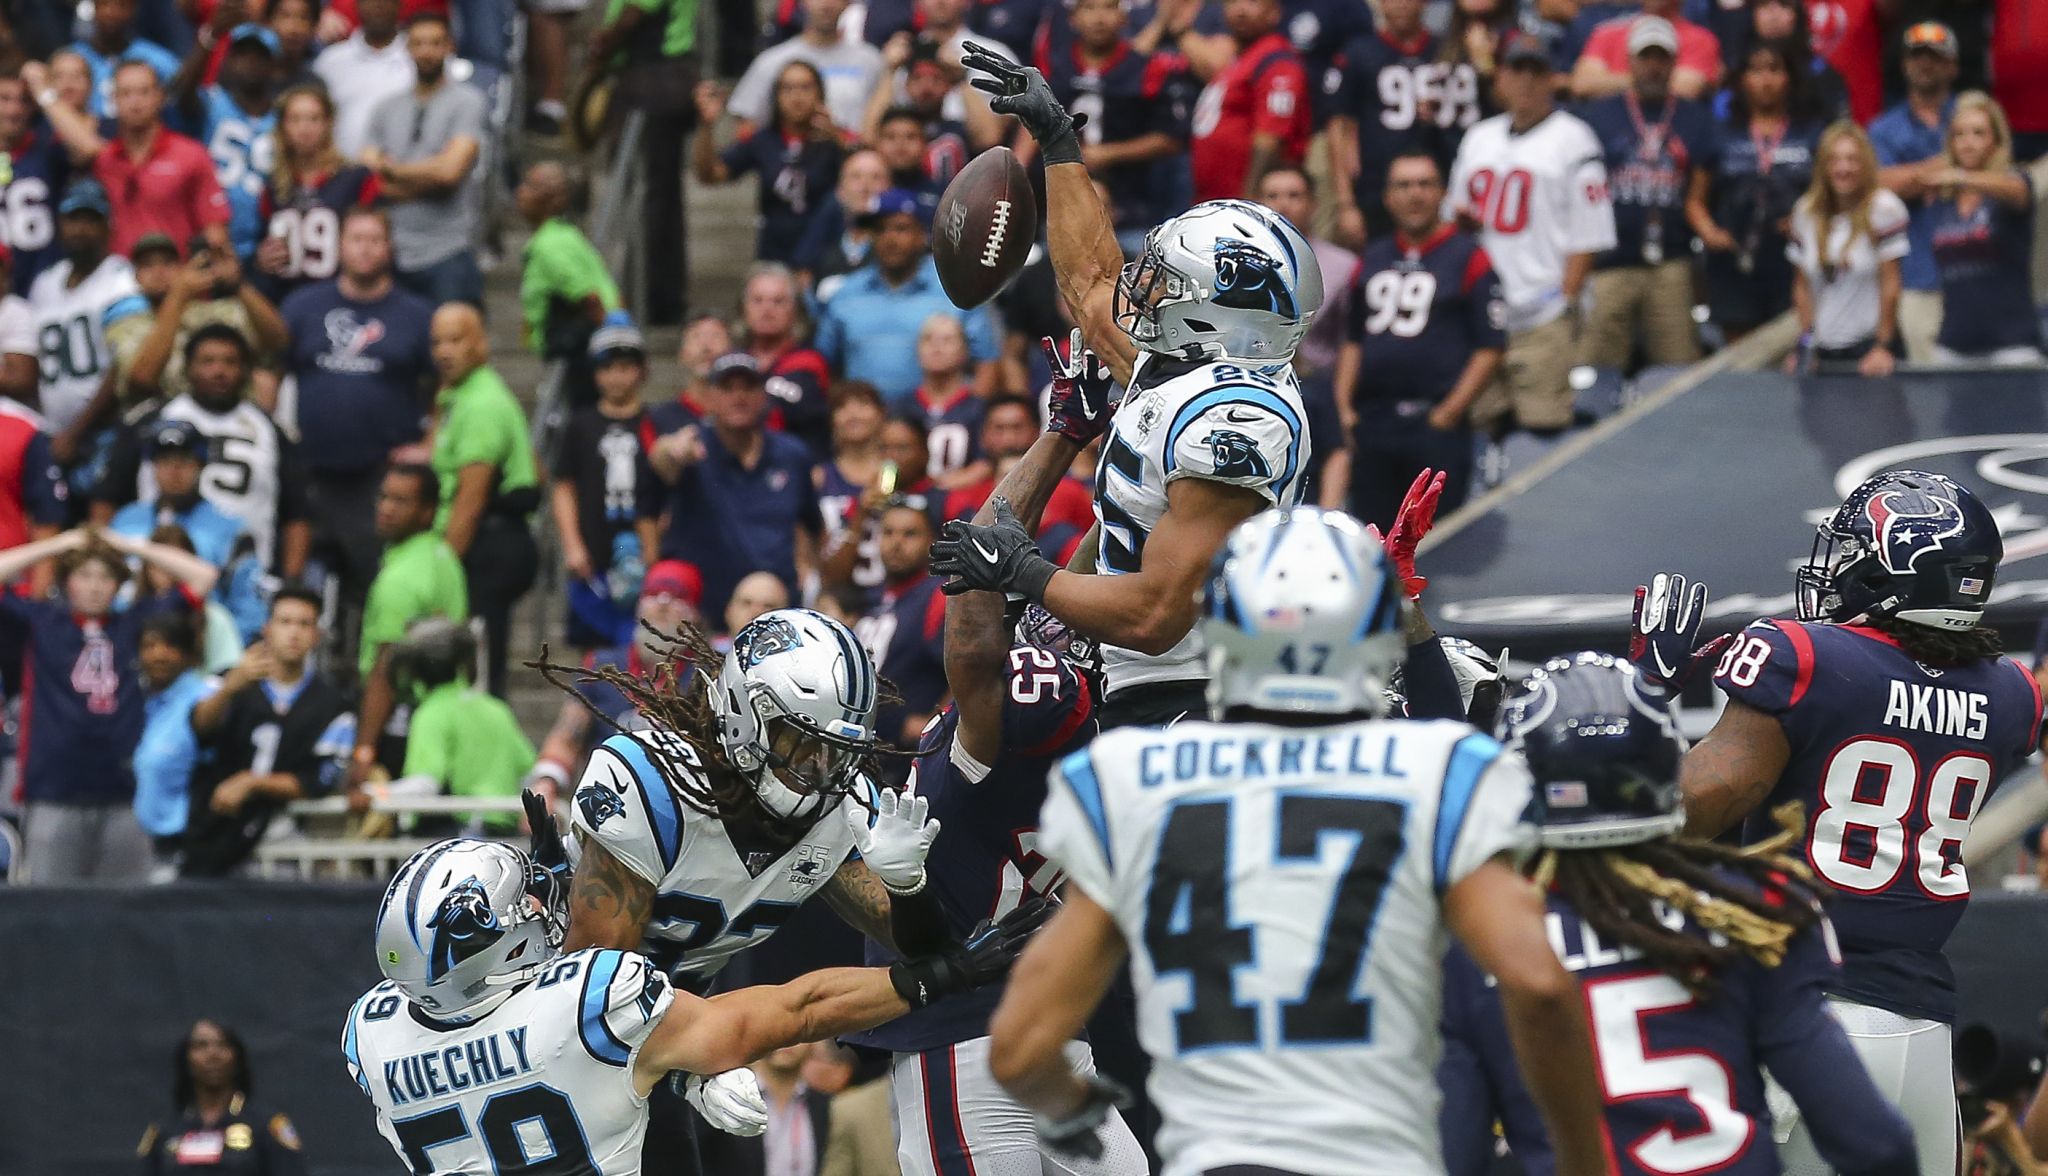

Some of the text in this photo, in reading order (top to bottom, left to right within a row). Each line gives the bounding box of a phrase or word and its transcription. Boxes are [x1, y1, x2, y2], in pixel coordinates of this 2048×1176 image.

[0, 177, 54, 251] 6
[1467, 168, 1532, 234] 90
[1365, 269, 1437, 337] 99
[70, 637, 120, 716] 4
[1008, 645, 1062, 704] 25
[1276, 643, 1331, 677] 47
[1883, 679, 1989, 741] AKINS
[251, 722, 283, 777] 1
[1139, 730, 1409, 788] COCKRELL
[1805, 733, 1996, 901] 88
[1143, 786, 1414, 1057] 47
[383, 1024, 533, 1106] KUECHLY
